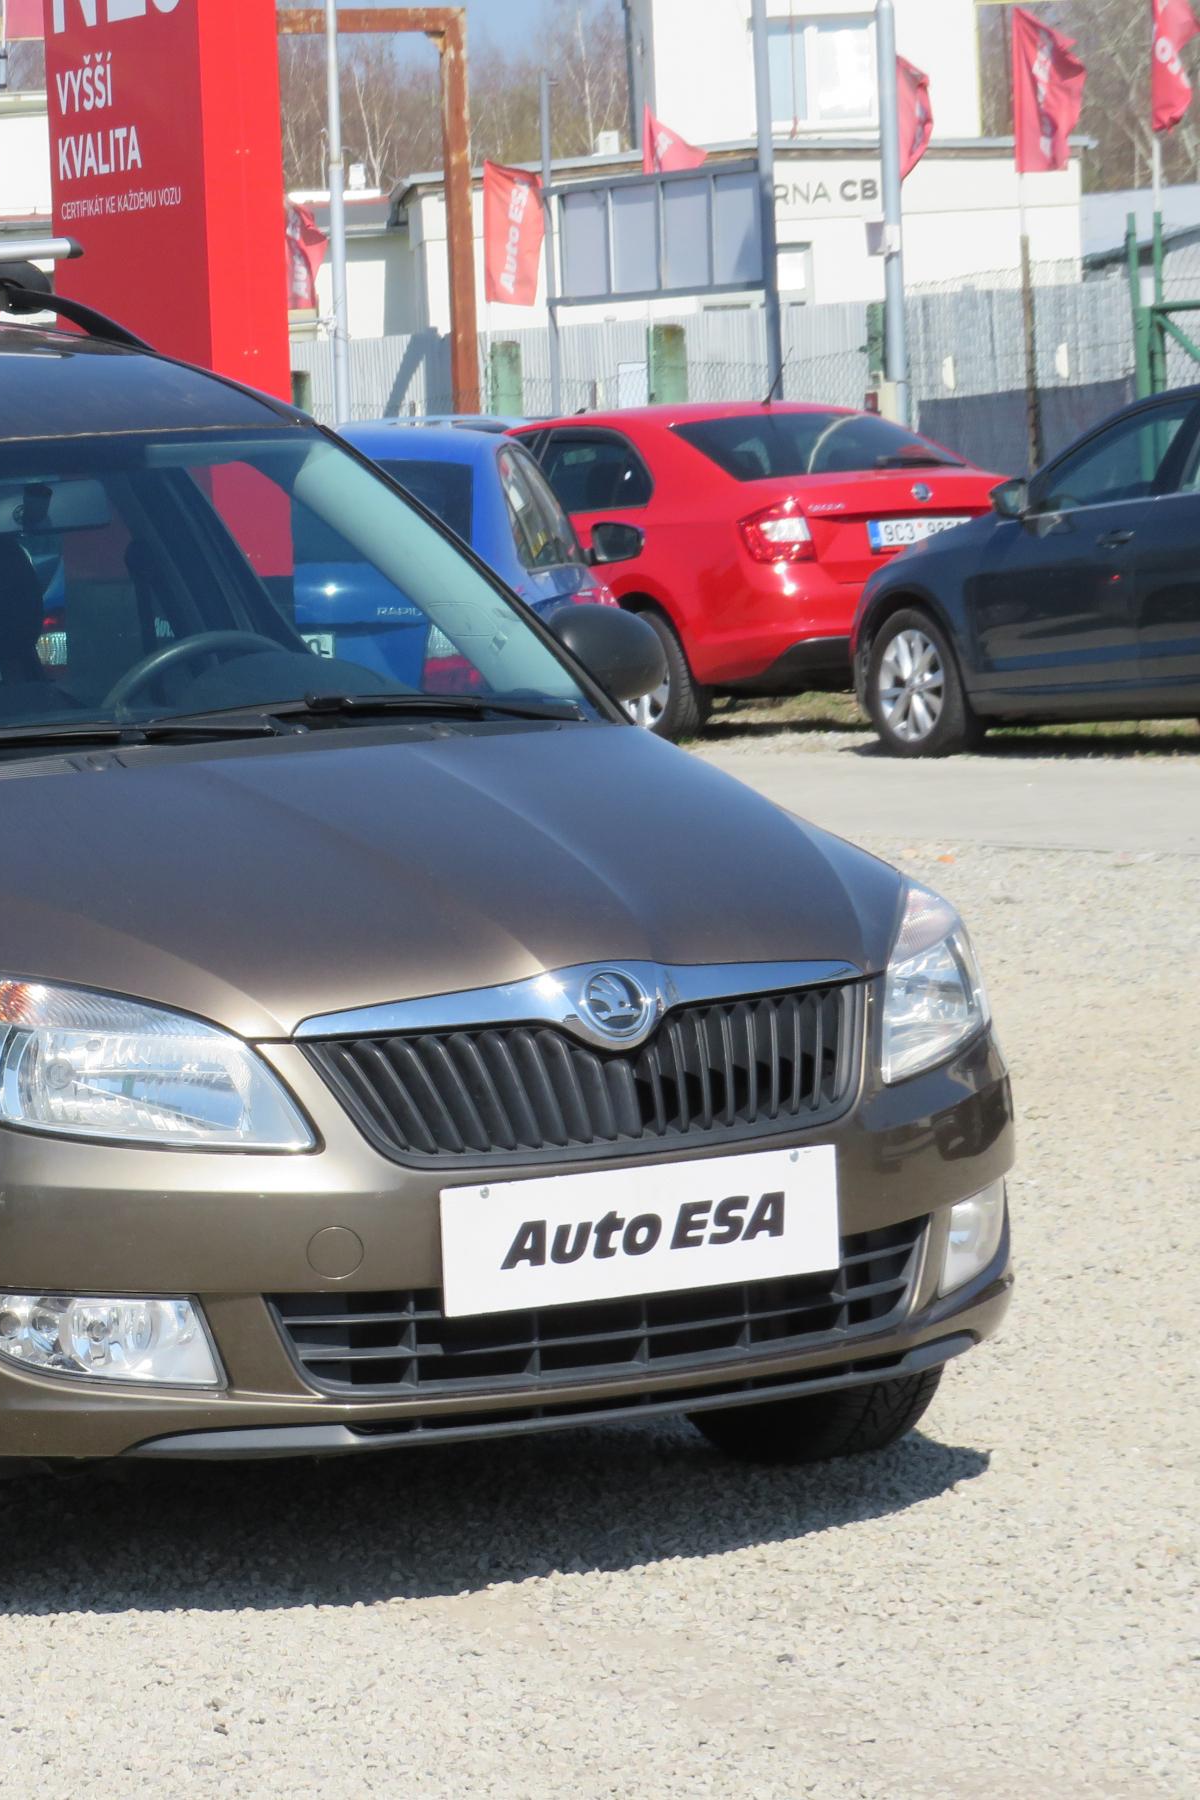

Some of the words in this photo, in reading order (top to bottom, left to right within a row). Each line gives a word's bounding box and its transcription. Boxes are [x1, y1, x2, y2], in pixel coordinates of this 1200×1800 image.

[56, 51, 113, 115] VYŠŠÍ
[58, 125, 142, 181] KVALITA
[61, 194, 103, 220] CERTIFIKÁT
[105, 196, 117, 214] KE
[117, 188, 157, 212] KAŽDÉMU
[157, 186, 182, 206] VOZU
[499, 225, 520, 295] Auto
[500, 1210, 662, 1270] Auto
[669, 1191, 785, 1250] ESA
